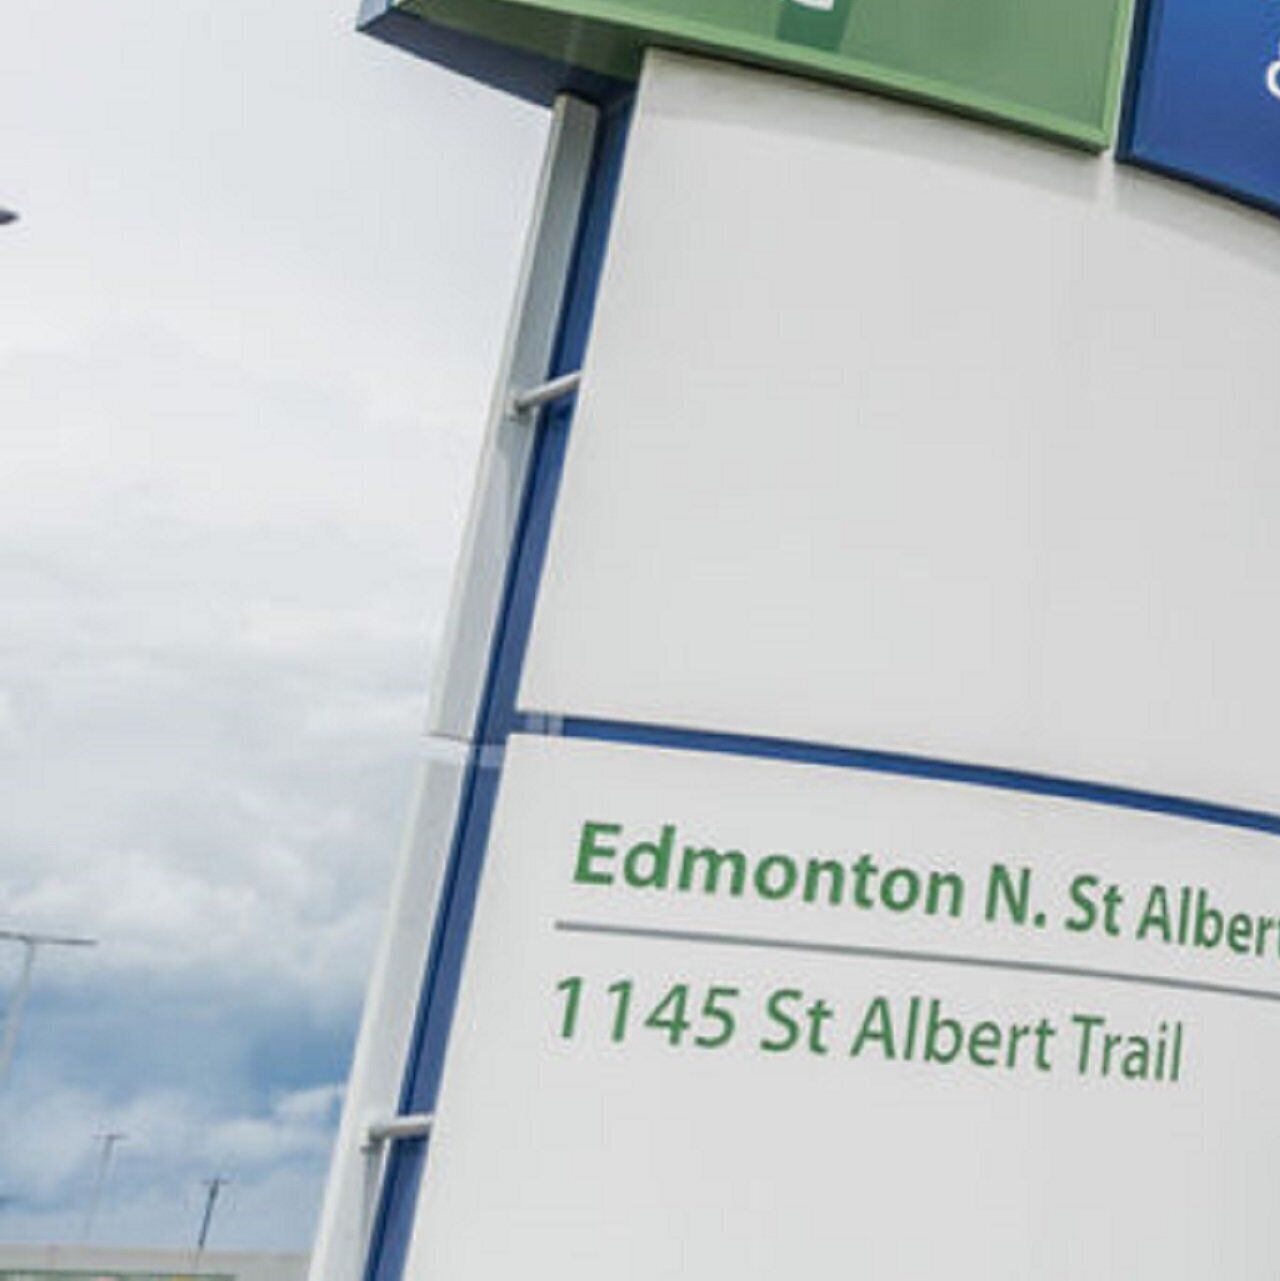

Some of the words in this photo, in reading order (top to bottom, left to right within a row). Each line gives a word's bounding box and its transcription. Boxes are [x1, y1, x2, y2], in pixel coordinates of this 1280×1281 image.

[572, 819, 965, 919] Edmonton
[984, 863, 1047, 928] N.
[1065, 873, 1124, 938] St
[554, 975, 740, 1051] 1145
[760, 988, 832, 1055] St
[851, 996, 1056, 1073] Albert
[1070, 1013, 1184, 1083] Trail
